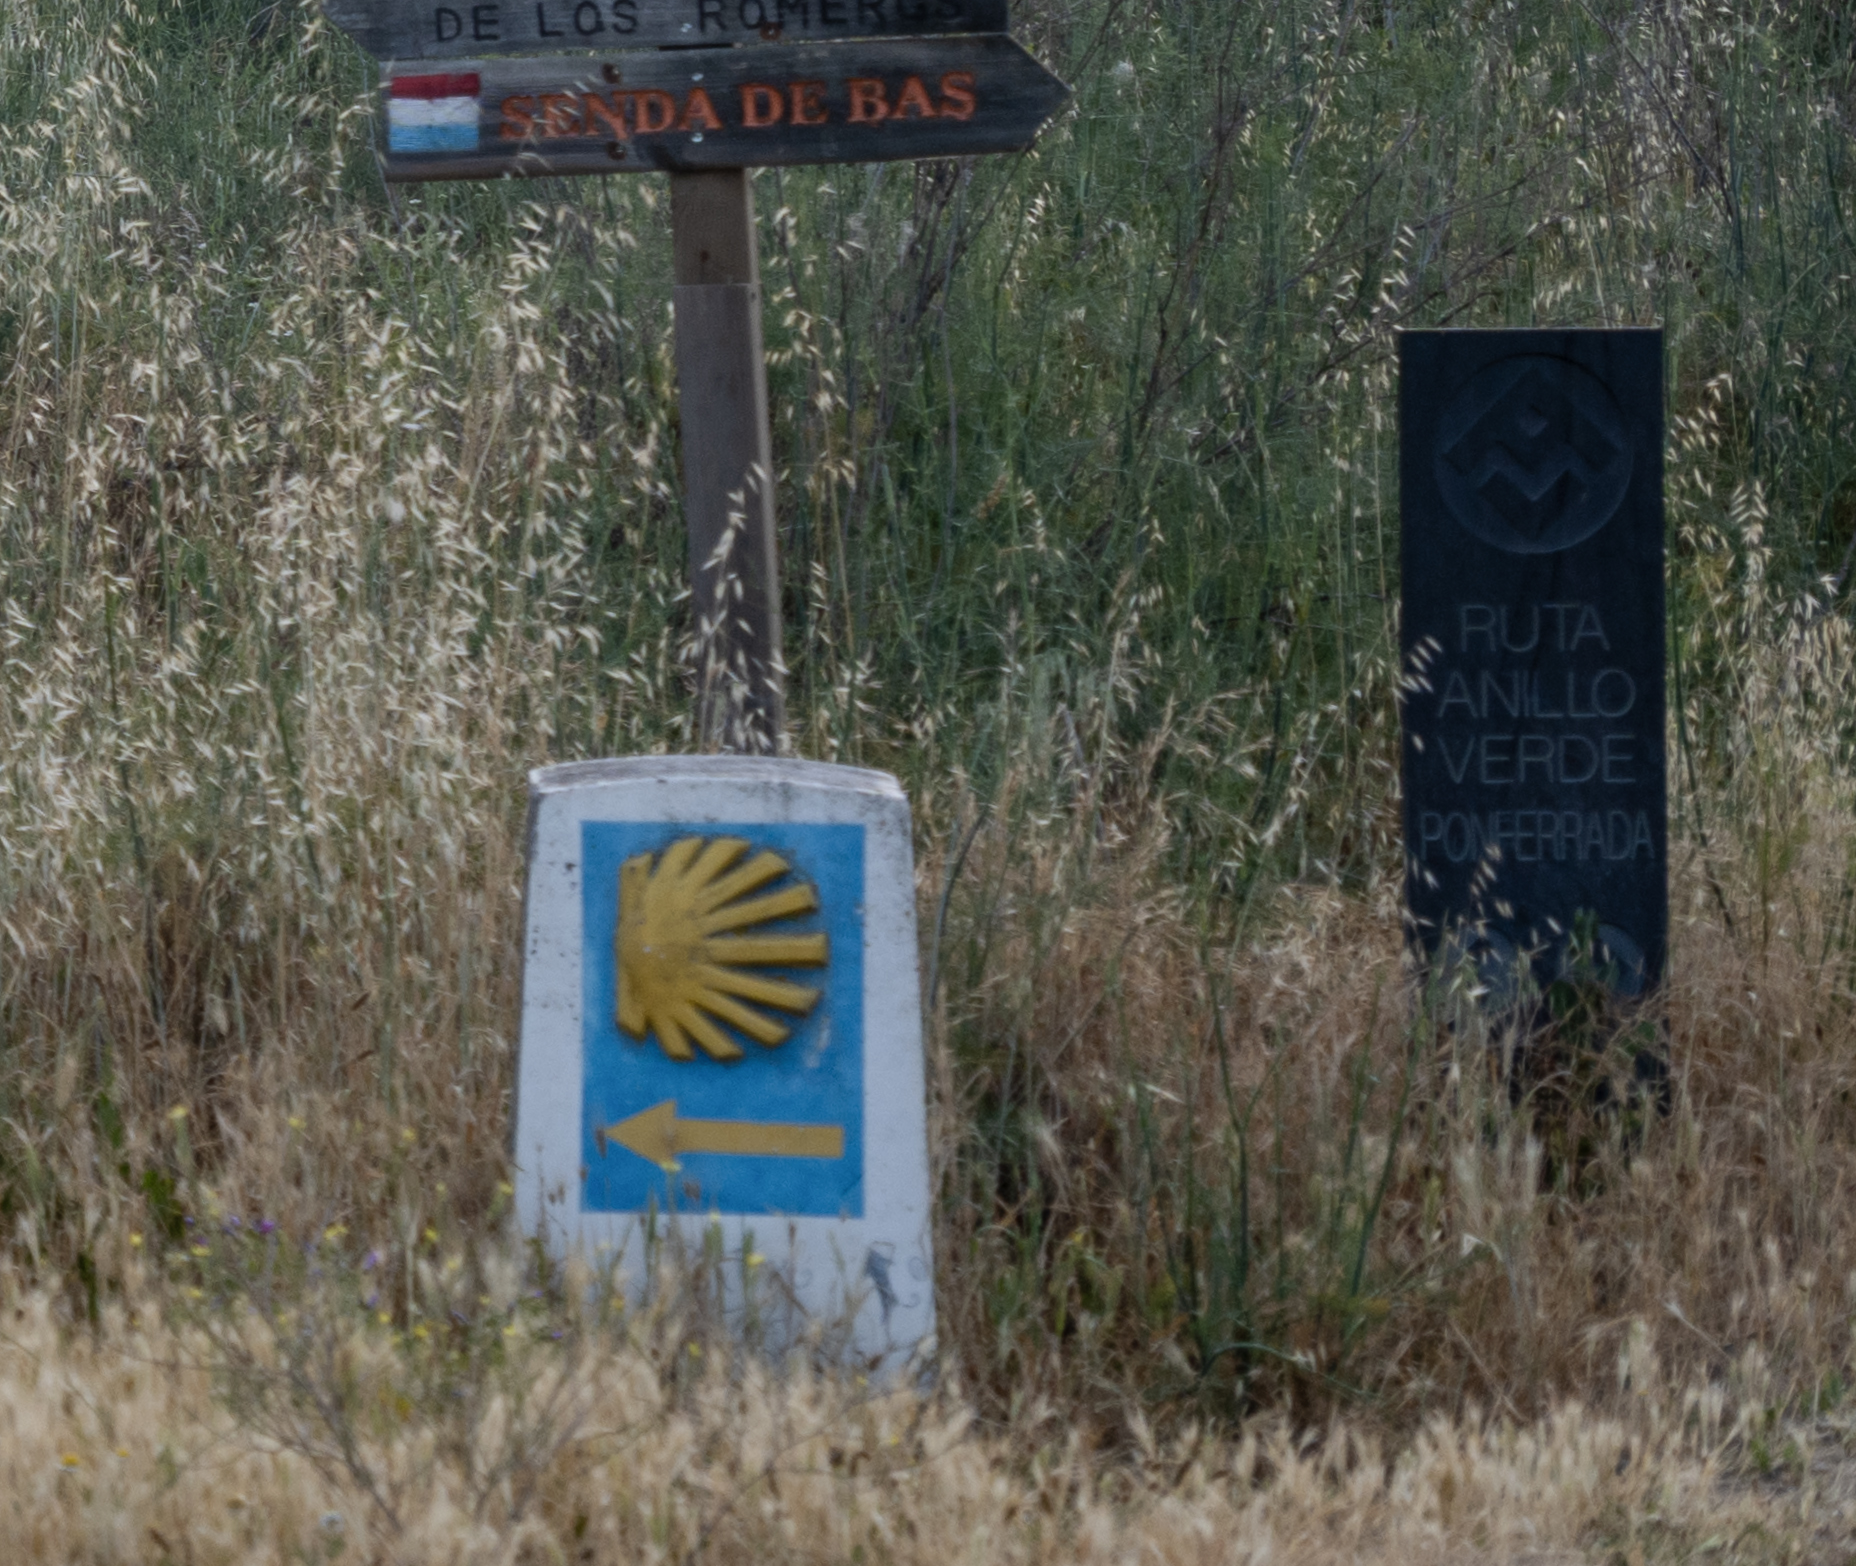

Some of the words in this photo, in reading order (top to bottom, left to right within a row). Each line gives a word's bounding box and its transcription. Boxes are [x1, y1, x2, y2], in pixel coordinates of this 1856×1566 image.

[435, 5, 501, 43] DE
[499, 86, 723, 140] SENDA
[741, 80, 829, 129] DE
[846, 70, 978, 124] BAS
[1460, 604, 1610, 652] RUTA
[1437, 667, 1637, 719] ANILLO
[1437, 734, 1636, 785] VERDE
[1420, 811, 1655, 861] PONFERRADA
